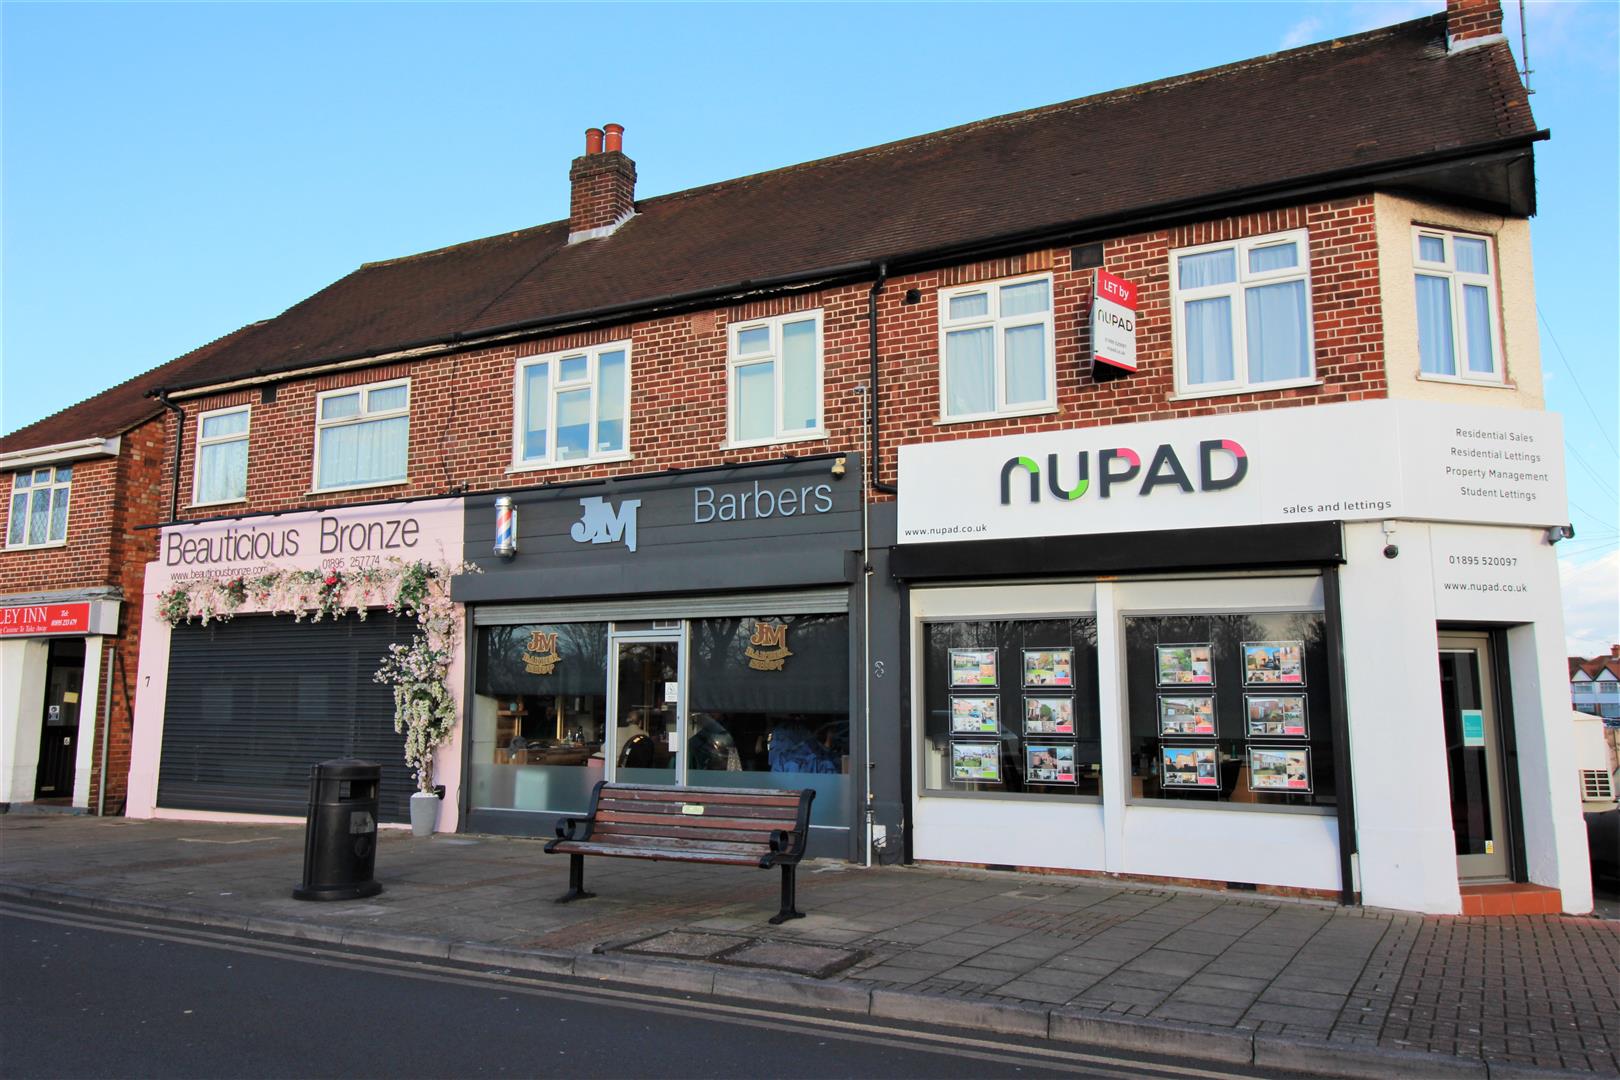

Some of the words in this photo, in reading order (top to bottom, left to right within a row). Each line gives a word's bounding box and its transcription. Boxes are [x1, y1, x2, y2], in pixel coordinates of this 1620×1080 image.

[1104, 279, 1118, 295] LET
[1119, 285, 1129, 301] by
[1455, 428, 1507, 441] Residential
[1509, 432, 1534, 443] Sales
[1450, 447, 1502, 459] Residential
[1504, 451, 1541, 463] Lettings
[1445, 466, 1486, 479] Property
[1489, 469, 1549, 481] Management
[1460, 486, 1497, 498] Student
[1500, 489, 1536, 501] Lettings
[694, 480, 833, 524] Barbers
[1283, 504, 1314, 514] sales
[1317, 502, 1340, 512] and
[1344, 500, 1392, 511] lettings
[571, 496, 642, 552] JM
[904, 524, 988, 536] www.nupad.co.uk
[166, 526, 300, 566] Beauticious
[320, 516, 420, 554] Bronze
[322, 557, 345, 569] 01895
[350, 555, 380, 568] 257774
[1449, 555, 1479, 565] 01895
[1482, 556, 1517, 566] 520097
[1444, 583, 1528, 592] www.nupad.co.uk
[23, 606, 48, 624] INN
[527, 630, 558, 655] JM
[750, 622, 788, 649] JM
[145, 676, 151, 687] 7
